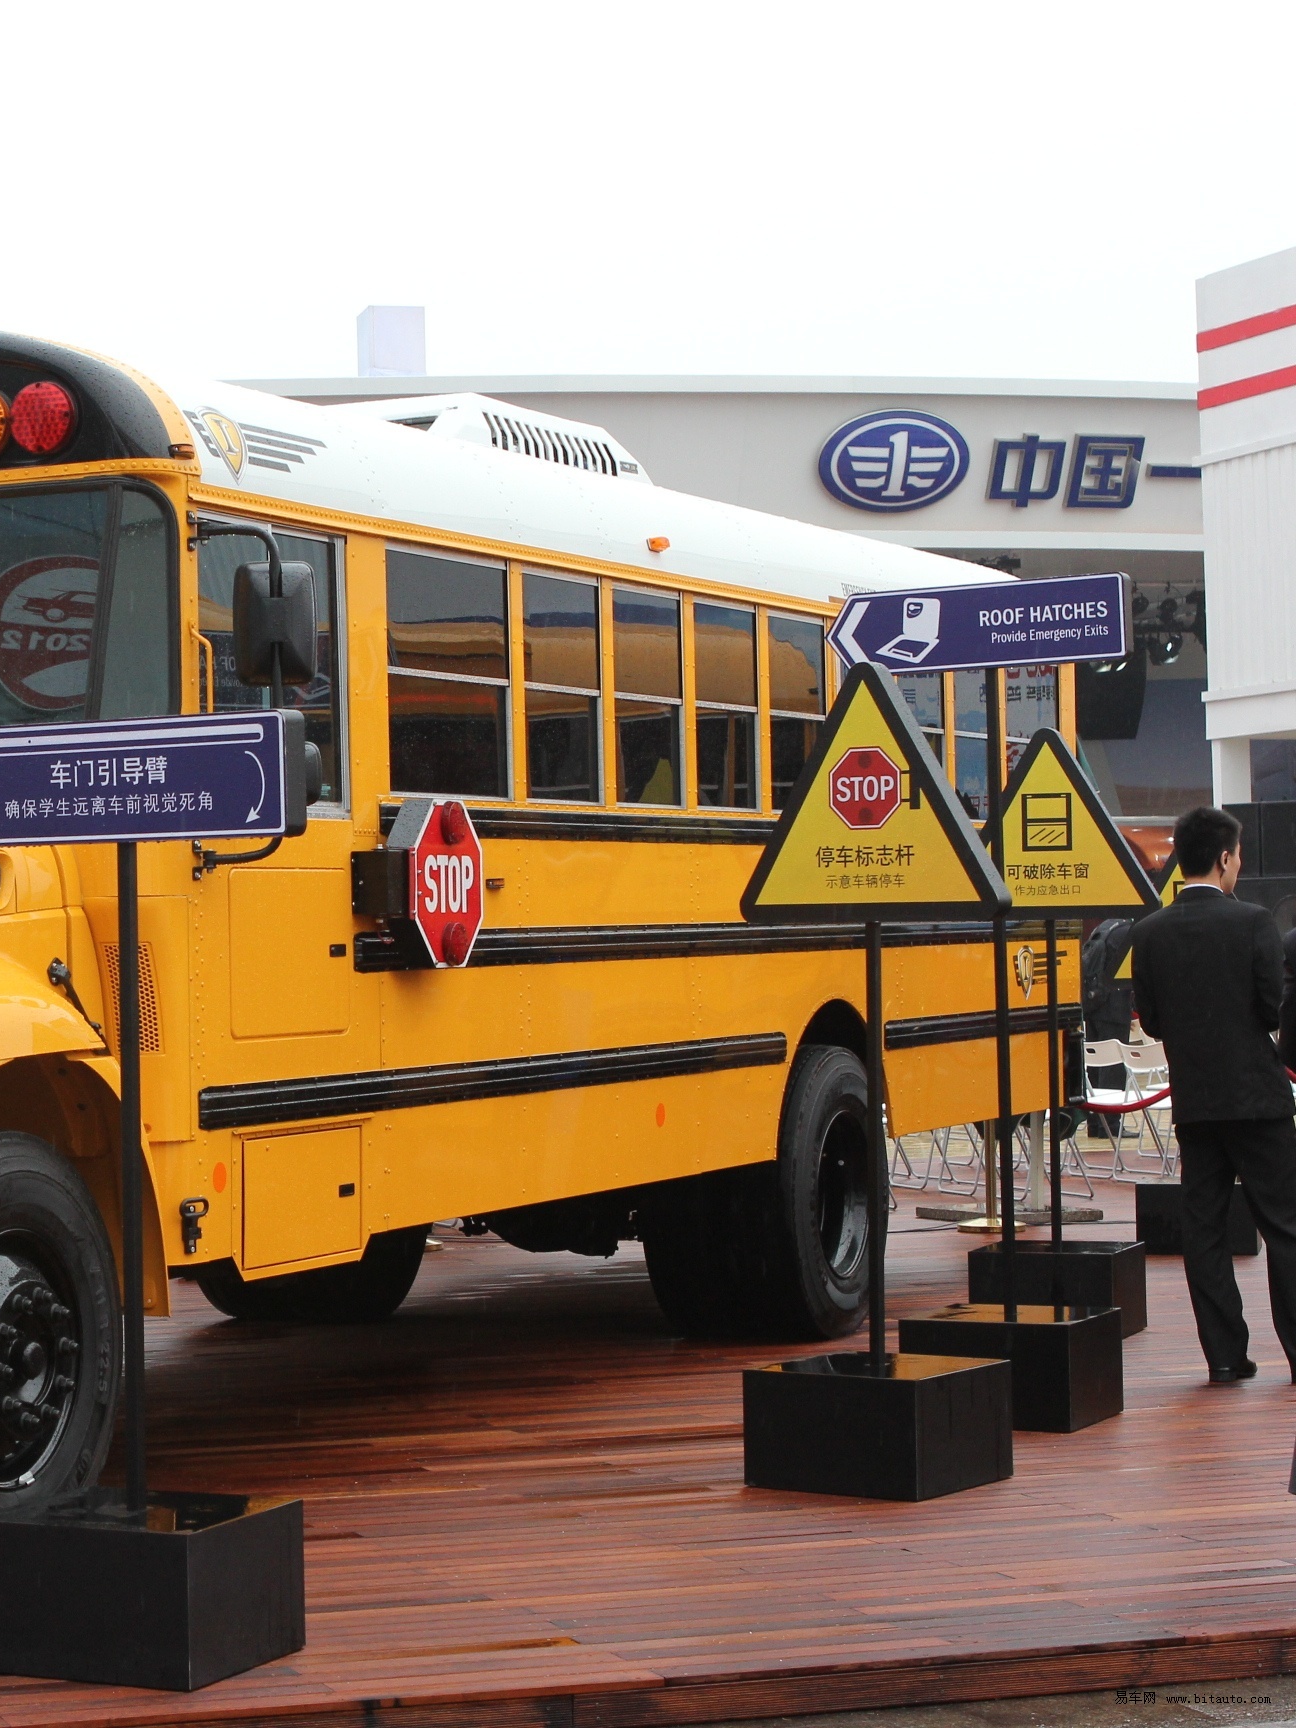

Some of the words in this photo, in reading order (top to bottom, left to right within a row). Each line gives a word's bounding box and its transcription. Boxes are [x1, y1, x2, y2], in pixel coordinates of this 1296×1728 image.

[979, 606, 1025, 628] ROOF
[1029, 600, 1108, 624] HATCHES
[991, 630, 1027, 644] Provide
[1029, 626, 1082, 642] Emergency
[1085, 624, 1109, 637] Exits
[50, 755, 168, 789] 车门引导臂
[836, 774, 895, 803] STOP
[4, 790, 214, 820] 确保学生远离车前视觉死角
[814, 843, 915, 869] 停车标志杆
[424, 854, 475, 914] STOP
[824, 872, 906, 890] 示意车辆停车
[1006, 862, 1090, 881] 可破除车窗
[1013, 883, 1082, 897] 作为应急出口
